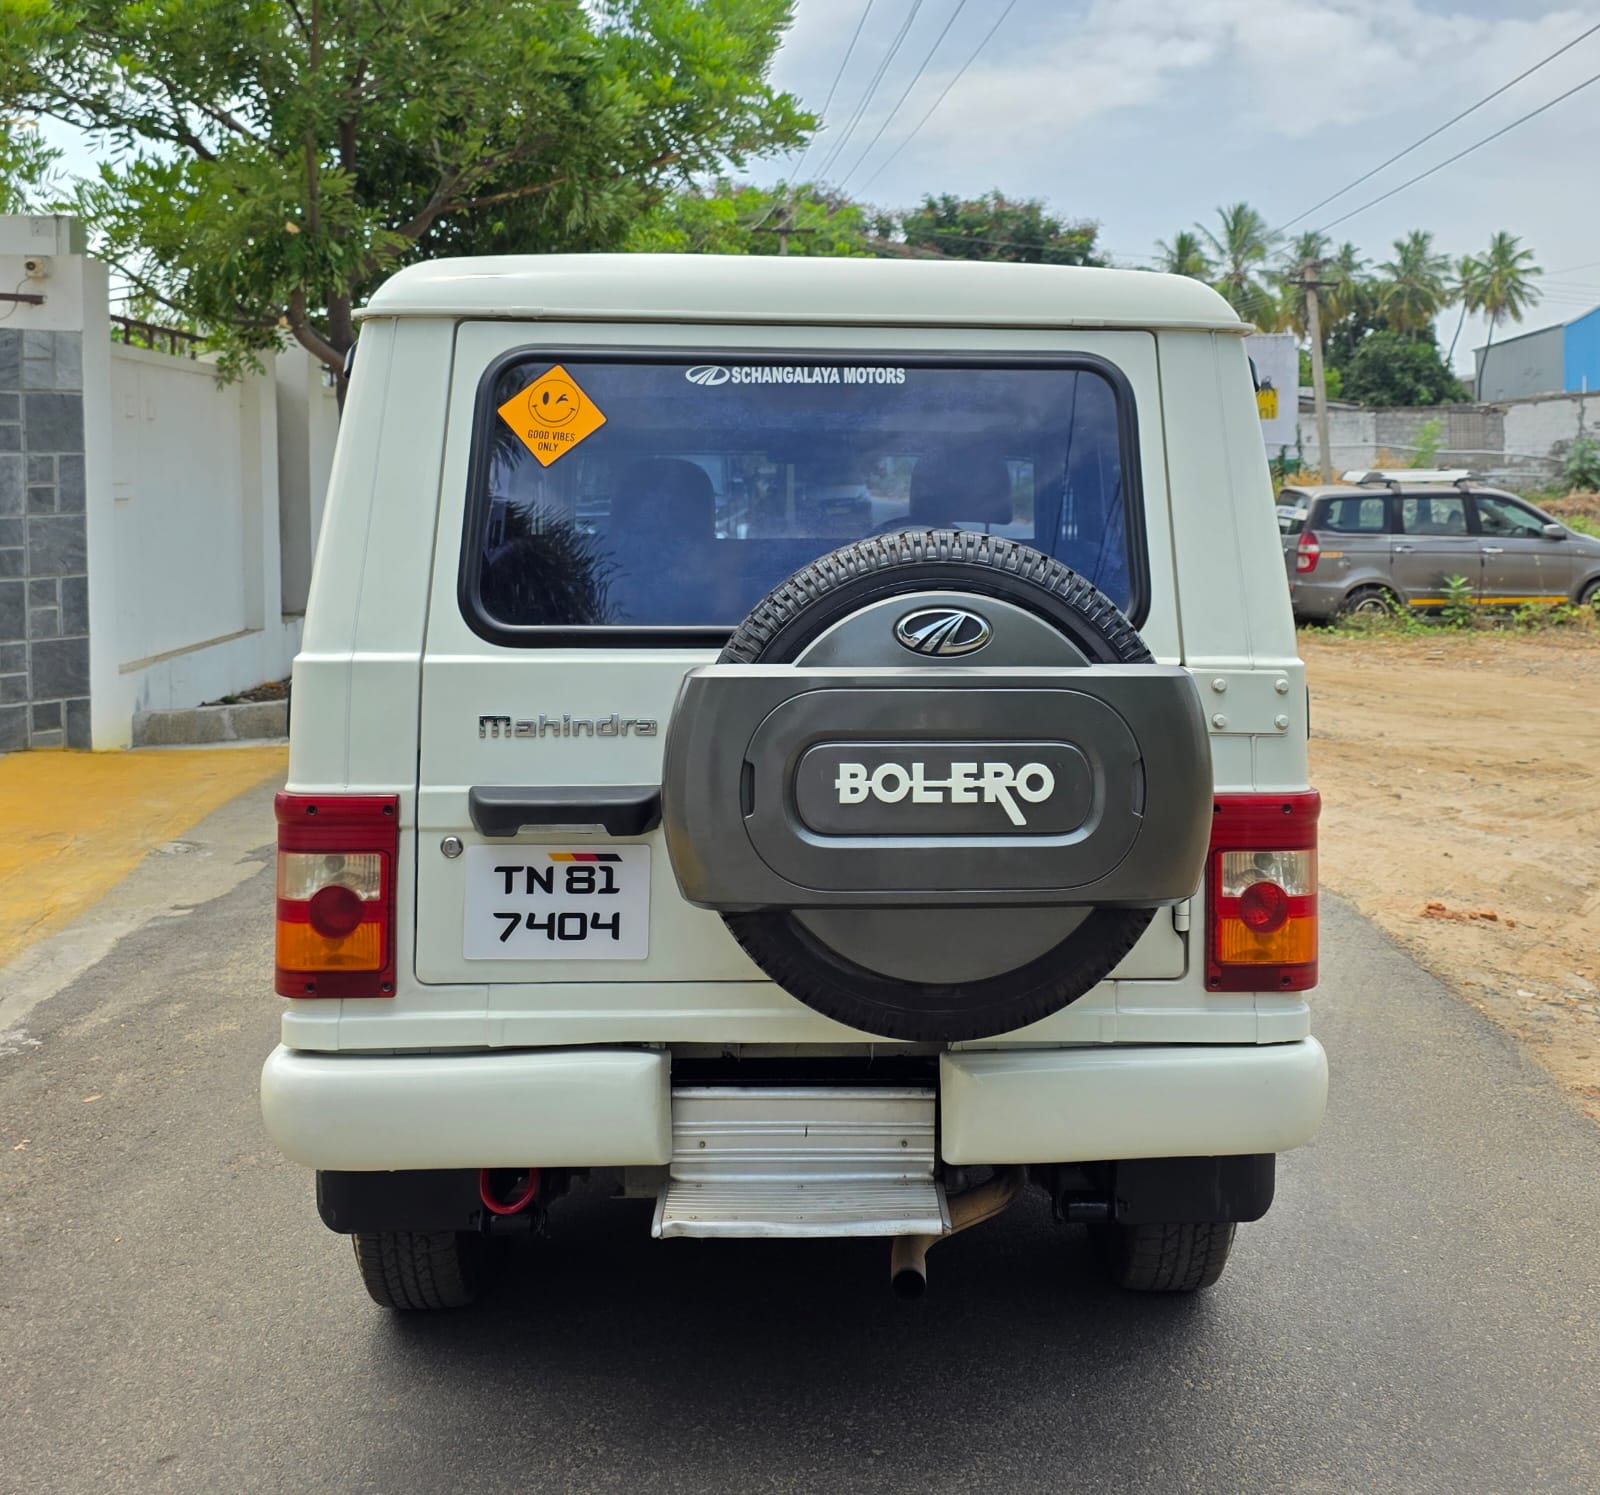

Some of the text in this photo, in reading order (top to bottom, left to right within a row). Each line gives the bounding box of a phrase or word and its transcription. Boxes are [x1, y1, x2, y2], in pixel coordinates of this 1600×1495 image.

[731, 366, 906, 384] SCHANGALAYA MOTORS
[527, 429, 576, 442] GOOD VIBES
[537, 441, 559, 452] ONLY
[479, 712, 658, 739] Mahindra
[834, 762, 1055, 826] BOLERO
[494, 865, 620, 895] TN 81
[492, 911, 621, 943] 7404
